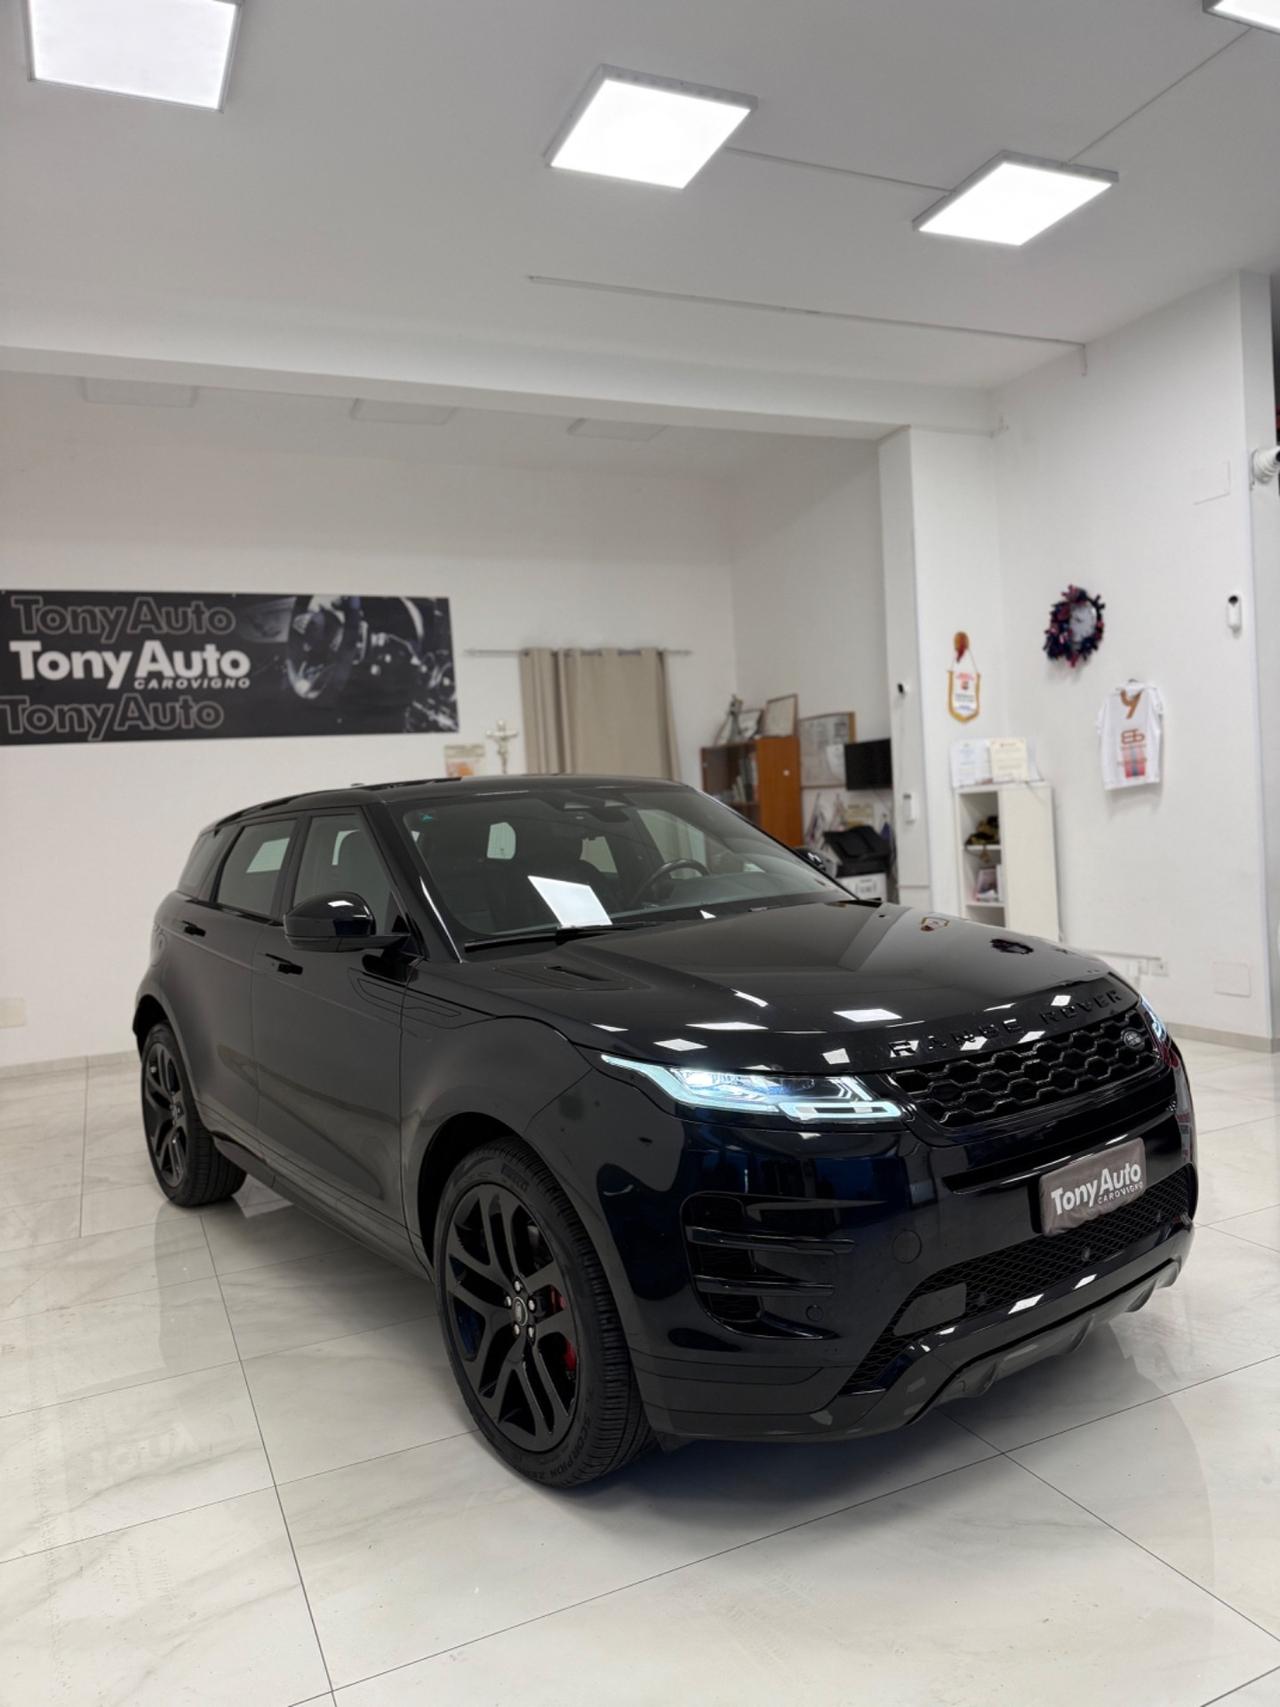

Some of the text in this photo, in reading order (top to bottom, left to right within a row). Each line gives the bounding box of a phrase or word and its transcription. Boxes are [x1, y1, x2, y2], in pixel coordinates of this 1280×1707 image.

[10, 595, 236, 643] Tony Auto
[9, 640, 251, 690] Tony Auto
[134, 678, 251, 689] CAROVIGNO
[0, 693, 224, 742] Tony Auto
[888, 990, 1123, 1057] RANGE ROVER
[1051, 1163, 1142, 1216] Tony Auto
